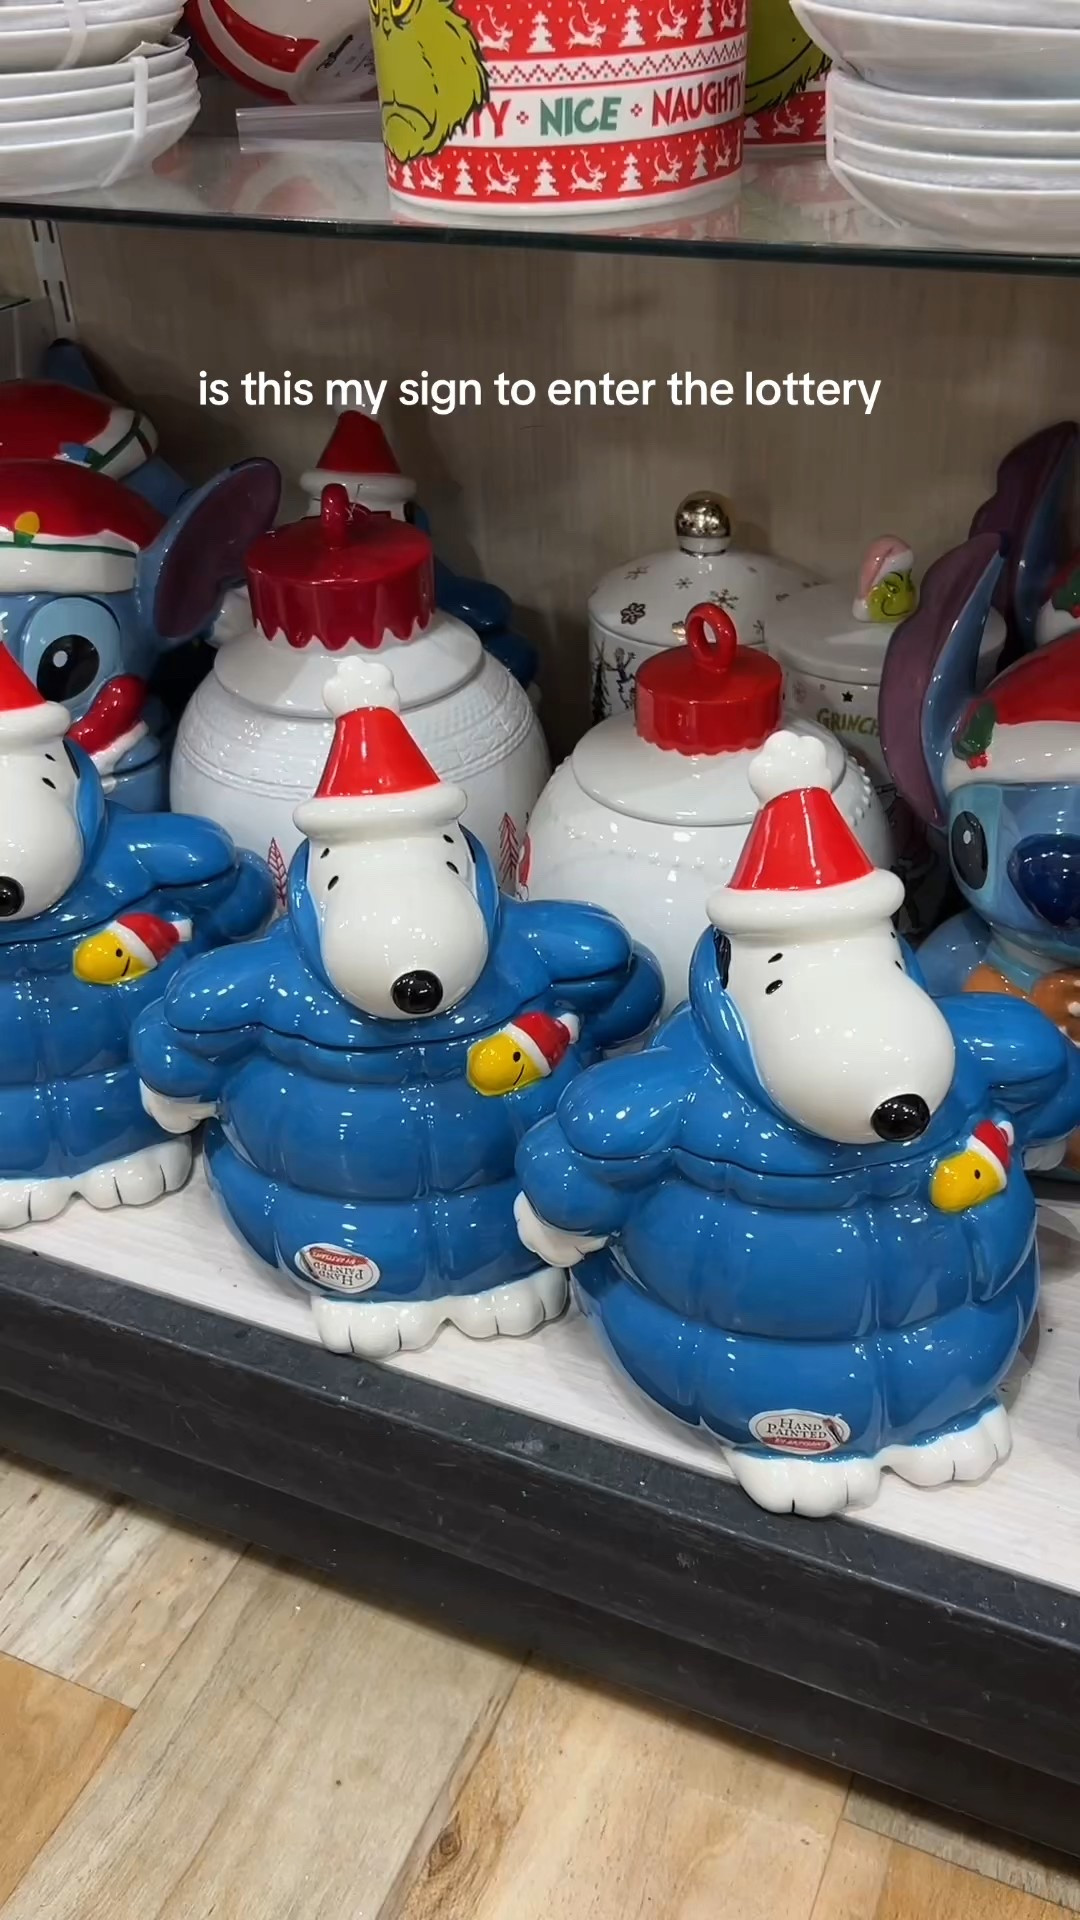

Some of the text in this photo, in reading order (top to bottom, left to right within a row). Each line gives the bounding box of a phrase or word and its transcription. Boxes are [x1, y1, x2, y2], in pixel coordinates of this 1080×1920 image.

[470, 71, 744, 139] TY NICE NAUGHTY
[313, 1261, 365, 1280] PAINTED
[318, 1270, 353, 1286] HAND
[767, 1423, 827, 1439] PAINTED
[779, 1418, 823, 1431] HAND
